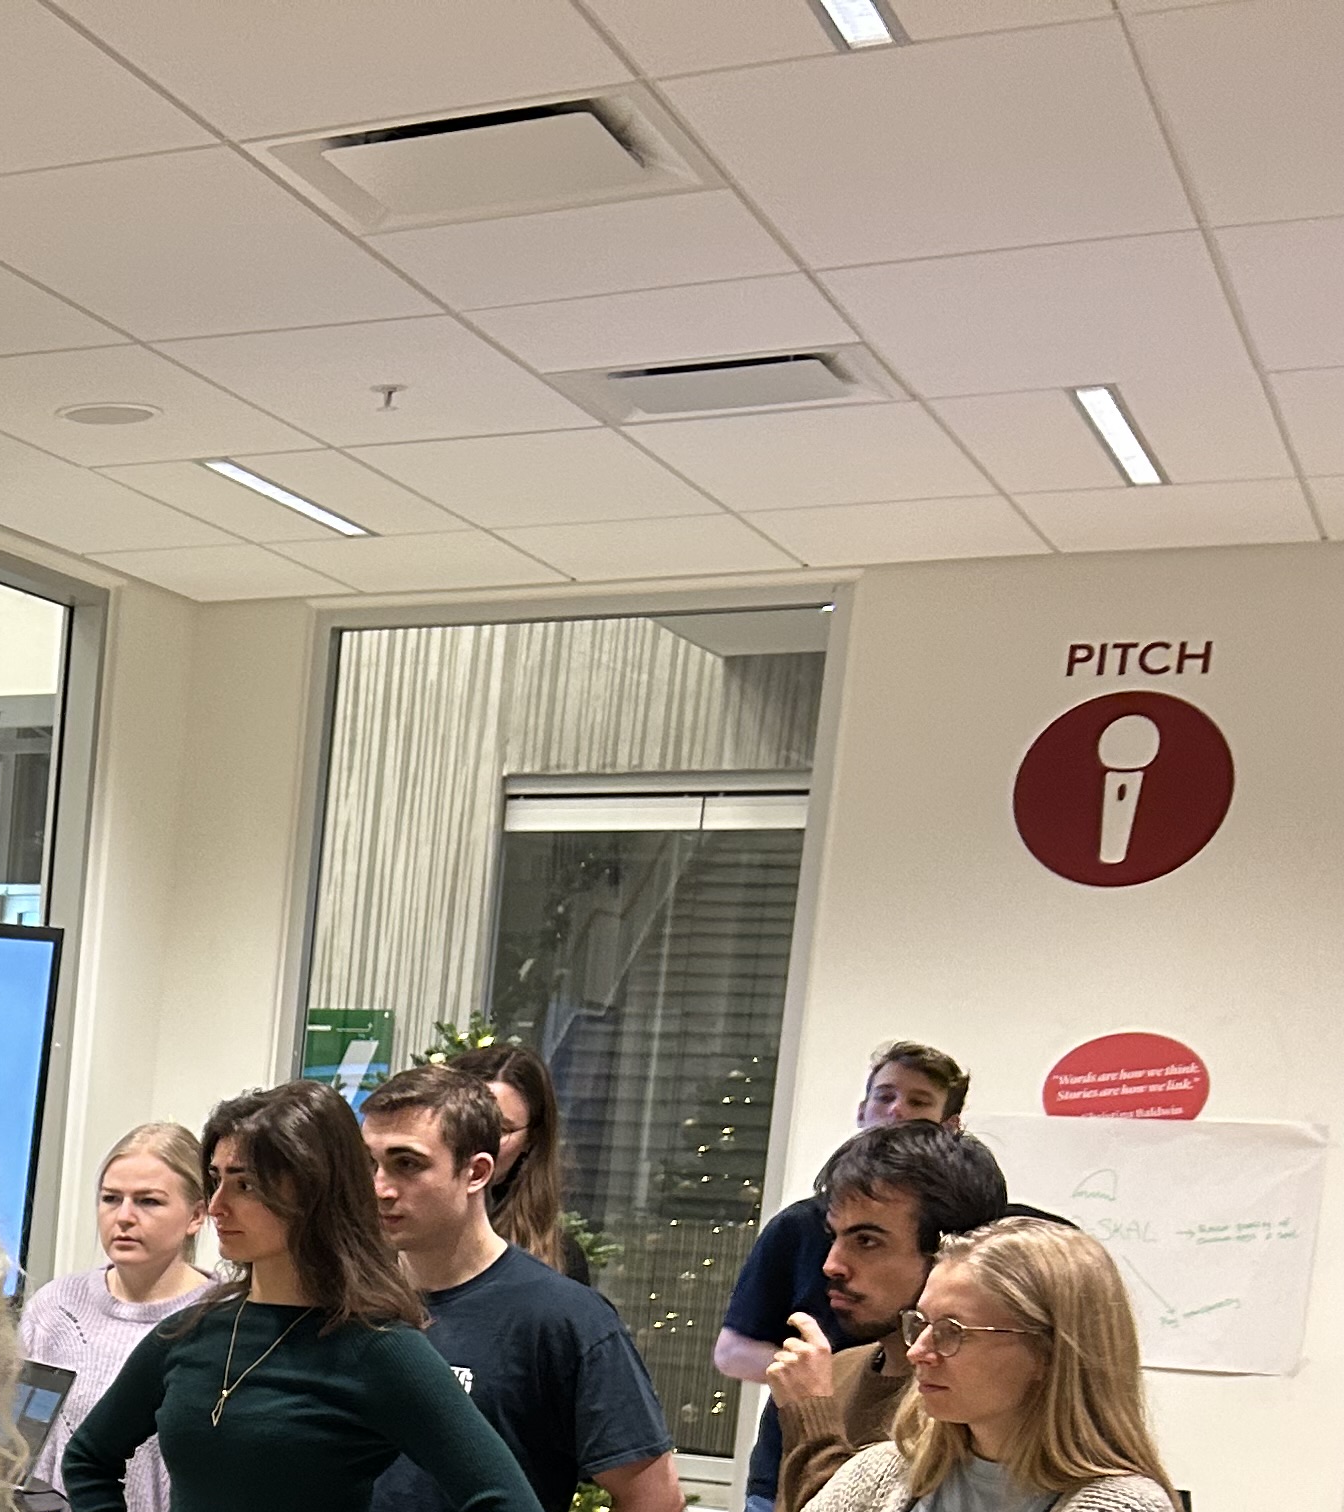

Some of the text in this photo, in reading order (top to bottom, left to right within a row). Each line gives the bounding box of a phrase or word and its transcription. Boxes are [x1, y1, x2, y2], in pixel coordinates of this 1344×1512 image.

[1065, 640, 1214, 677] PITCH
[1098, 1071, 1118, 1082] are
[1119, 1068, 1147, 1081] how
[1147, 1067, 1165, 1077] we
[1121, 1083, 1149, 1096] how
[1149, 1083, 1167, 1093] we
